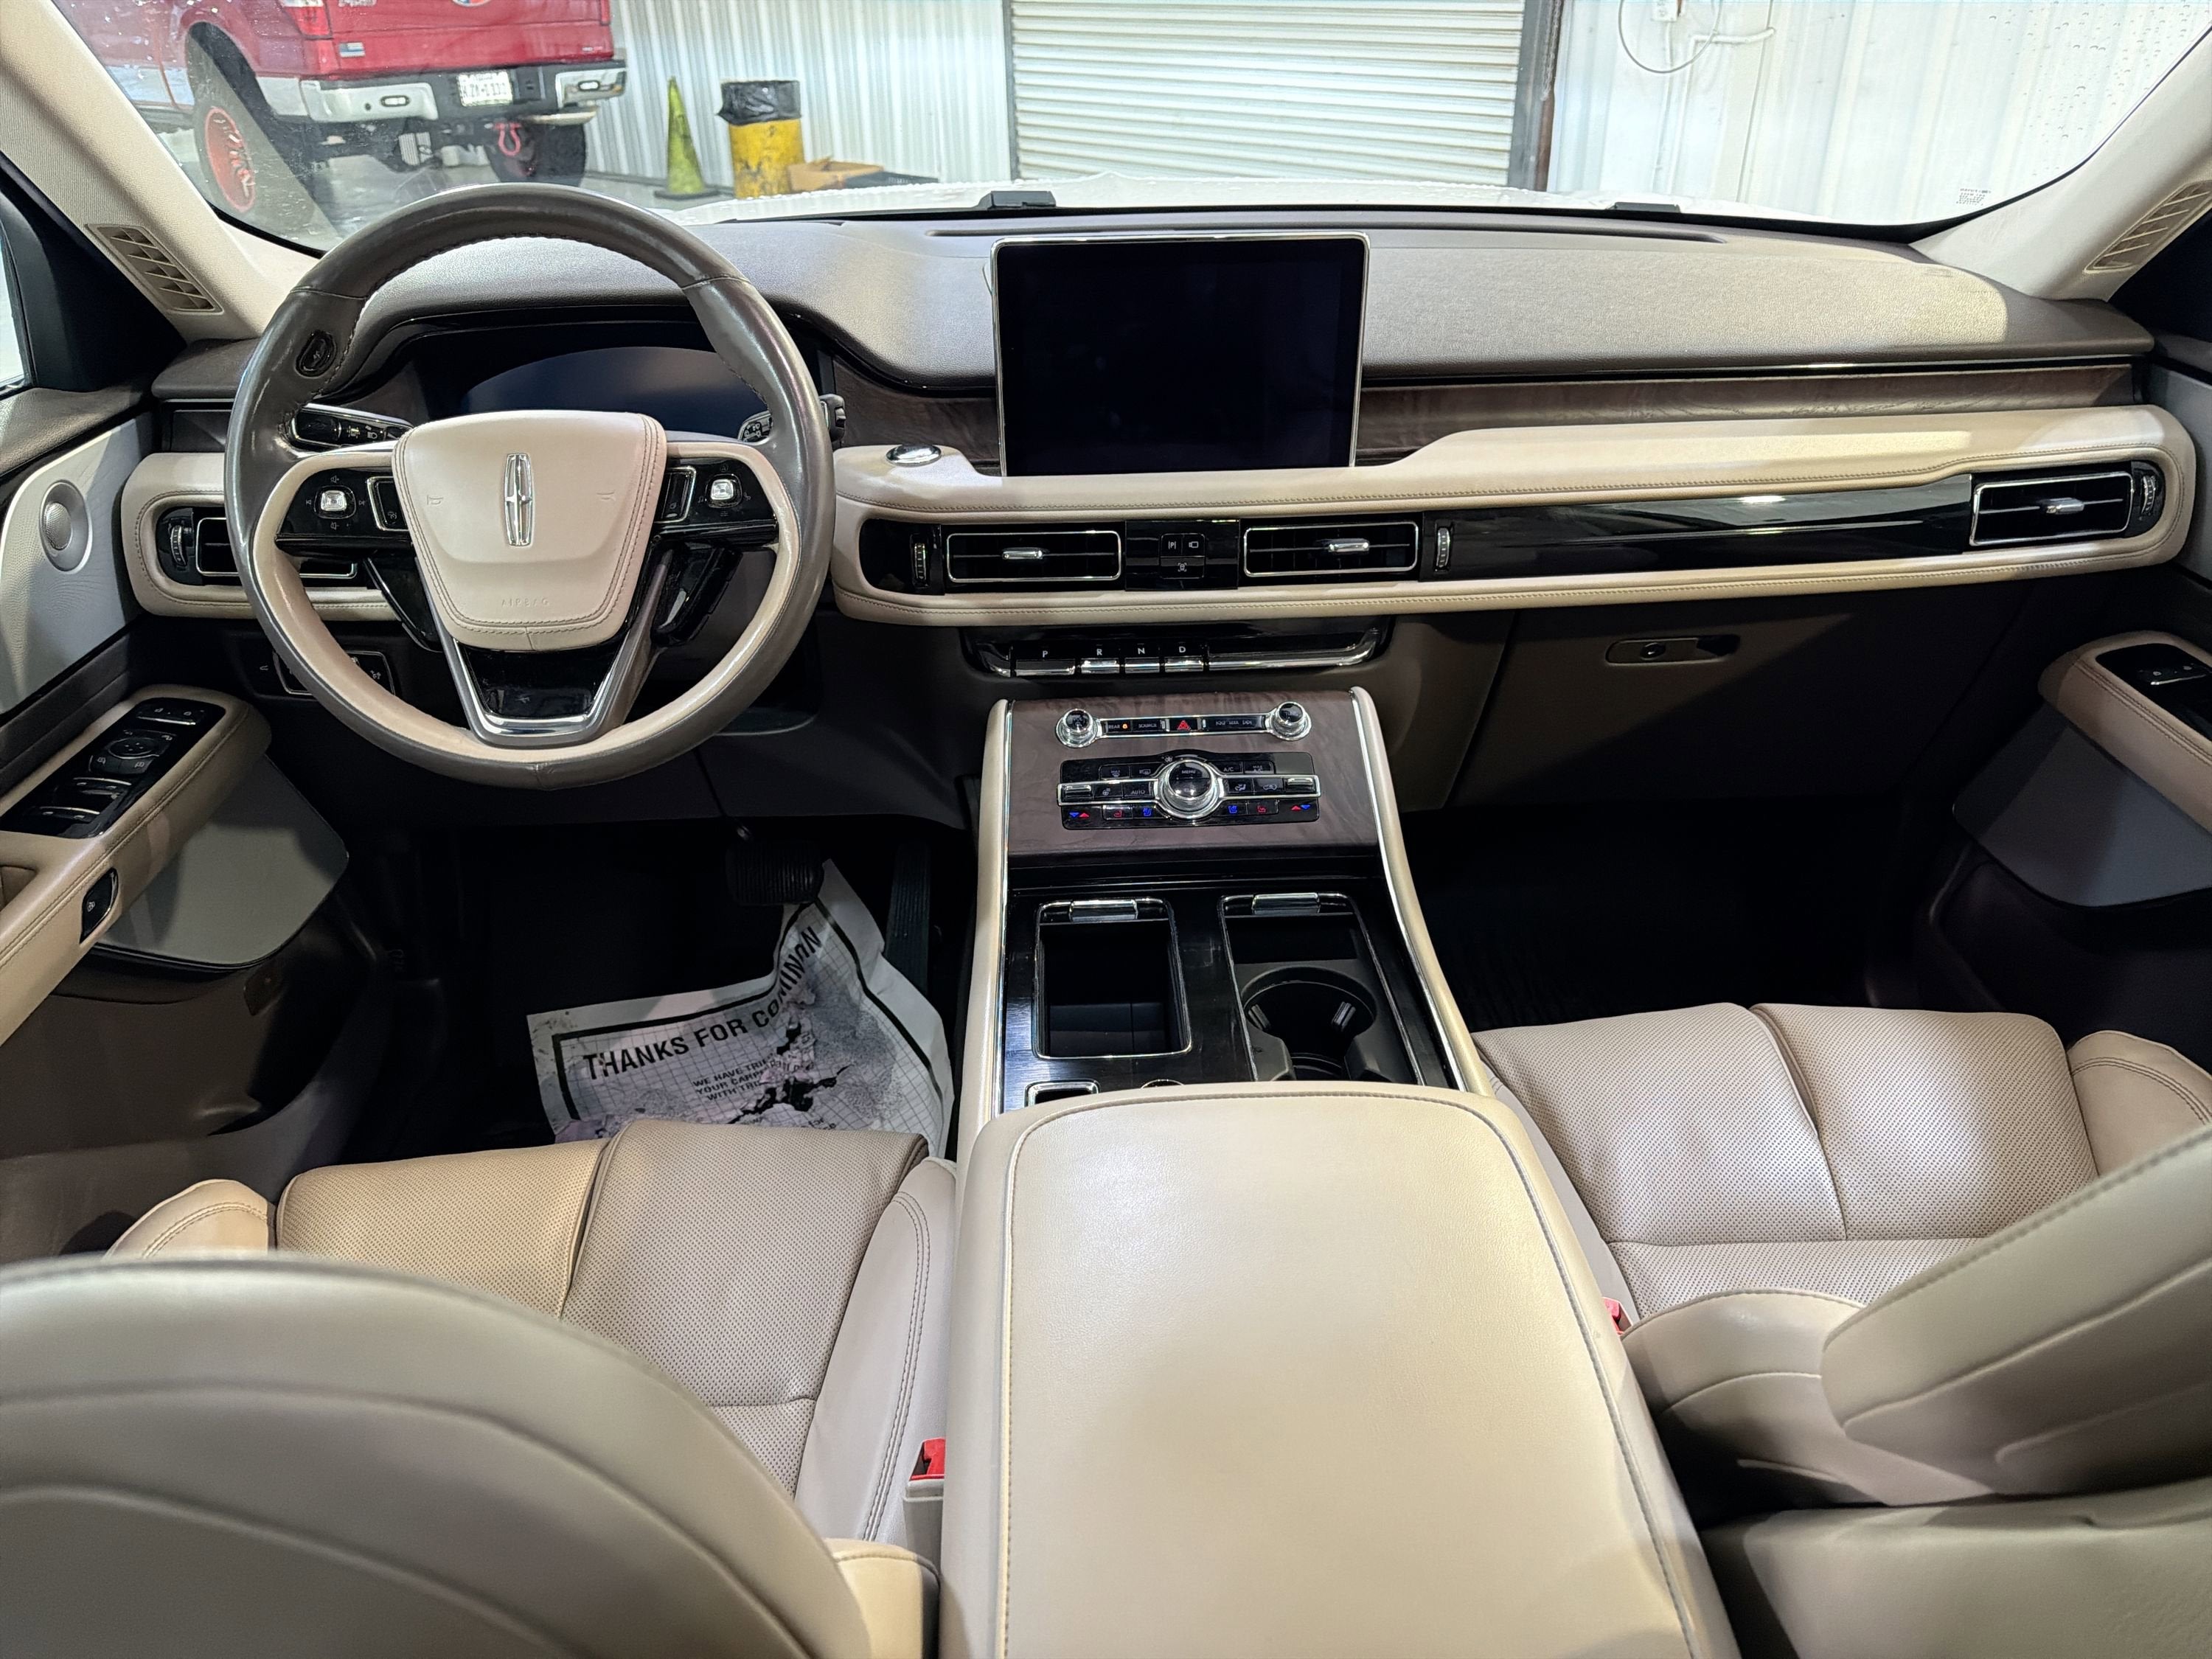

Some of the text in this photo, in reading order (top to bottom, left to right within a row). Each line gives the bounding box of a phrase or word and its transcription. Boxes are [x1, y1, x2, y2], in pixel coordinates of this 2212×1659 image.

[583, 1036, 689, 1079] THANKS
[694, 1018, 748, 1047] FOR
[692, 1076, 711, 1087] WE
[714, 1068, 743, 1082] HAVE
[696, 1082, 728, 1095] YOUR
[706, 1088, 737, 1102] WITH
